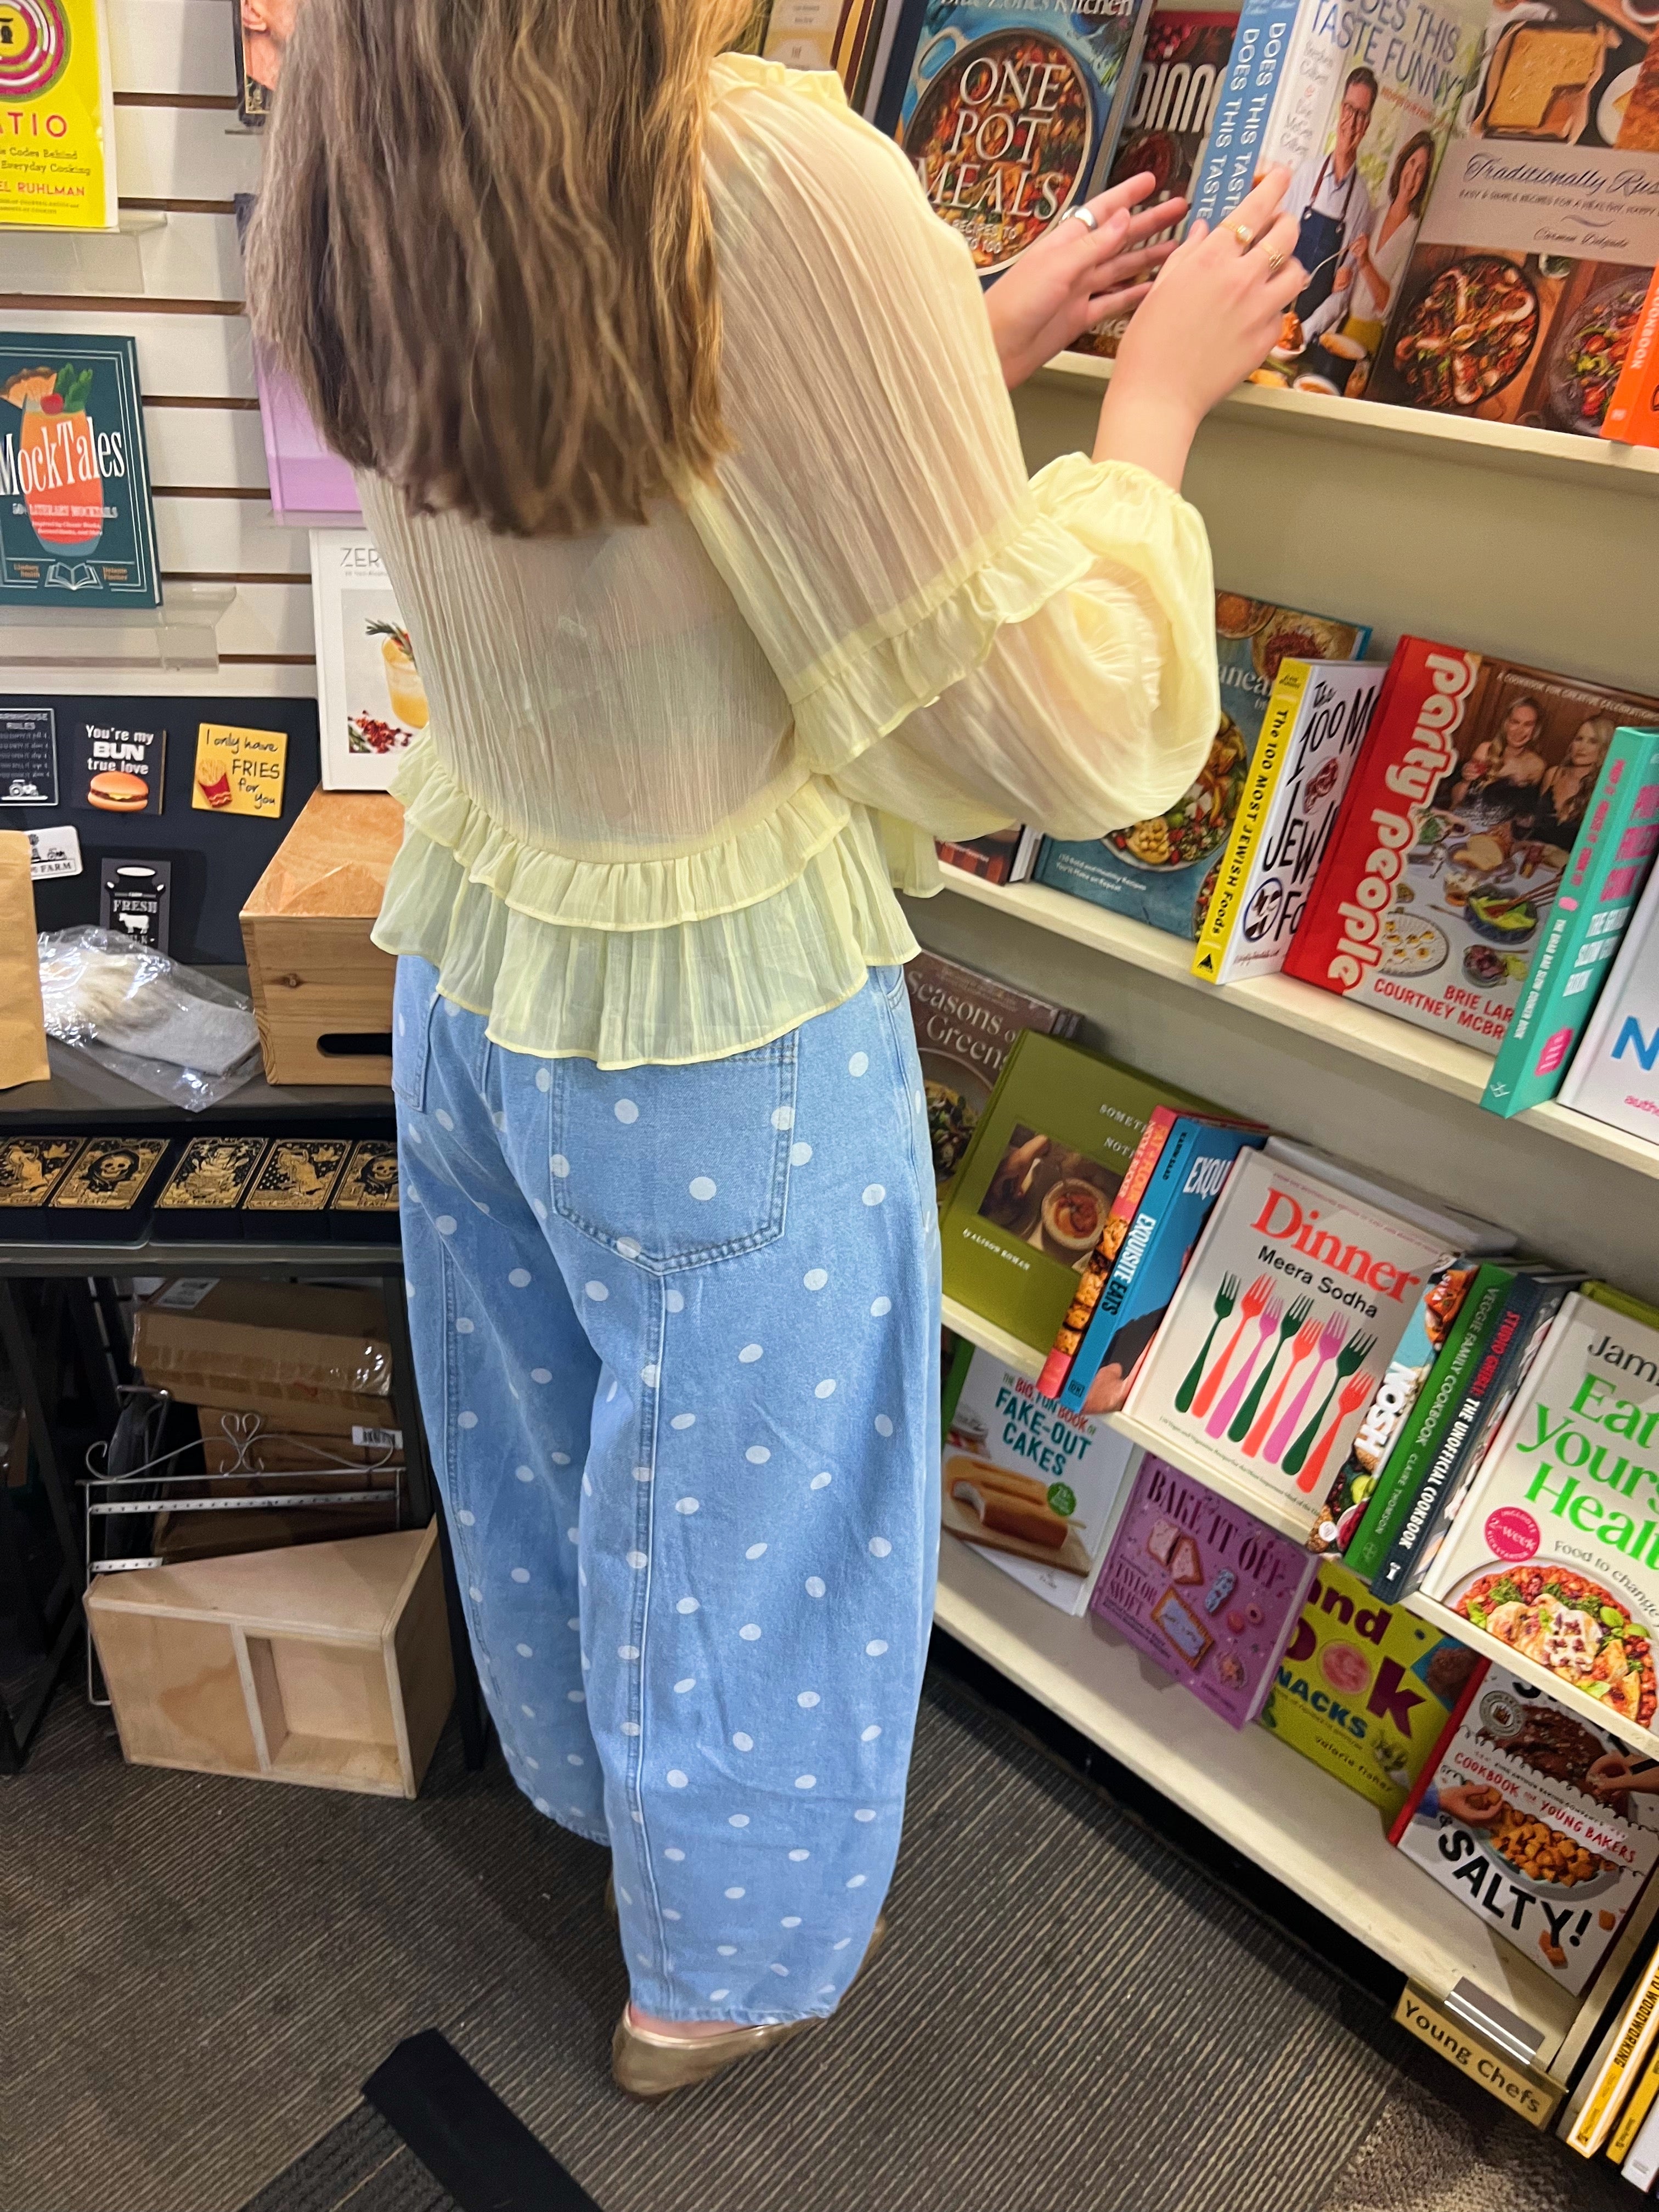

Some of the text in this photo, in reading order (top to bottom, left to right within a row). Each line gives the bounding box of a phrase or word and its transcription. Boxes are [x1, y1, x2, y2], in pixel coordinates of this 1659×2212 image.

[1256, 22, 1286, 86] DOES
[1312, 0, 1384, 66] TASTE
[1347, 0, 1460, 63] OES THIS
[960, 57, 1067, 111] ONE
[0, 112, 67, 138] TIO
[950, 109, 1053, 163] POT
[1196, 29, 1260, 218] DOES THIS TASTE
[1240, 93, 1268, 145] THIS
[18, 182, 84, 196] RUHLMAN
[916, 157, 1064, 220] MEALS
[1221, 151, 1252, 218] TASTE
[1463, 153, 1659, 197] Traditionally Rus
[0, 416, 125, 495] MockTales
[340, 548, 380, 567] ZER
[86, 724, 154, 746] You're my
[214, 733, 240, 754] only
[244, 736, 278, 753] have
[1271, 709, 1289, 738] The
[87, 758, 149, 775] true love
[93, 741, 144, 761] BUN
[232, 759, 280, 779] FRIES
[1262, 743, 1277, 770] 100
[238, 777, 261, 793] for
[254, 793, 275, 809] you
[1246, 774, 1269, 822] MOST
[1229, 825, 1254, 888] JEWISH
[1263, 780, 1340, 884] JEWI
[41, 862, 72, 873] FARM
[113, 899, 157, 913] FRESH
[1274, 891, 1307, 942] FO
[907, 970, 1003, 1035] Seasons
[1004, 1029, 1015, 1043] o
[1374, 978, 1506, 1040] COURTNEY MCBR
[1443, 985, 1515, 1023] BRIE LAR
[1099, 1104, 1147, 1133] SOMET
[1104, 1137, 1135, 1159] NOT
[1182, 1156, 1234, 1200] EXQU
[970, 1233, 1001, 1254] ALISON
[1001, 1249, 1031, 1272] ROMAN
[1102, 1213, 1156, 1316] EXQUISITE EATS
[1250, 1186, 1422, 1304] Dinner
[1257, 1245, 1378, 1319] Meera Sodha
[1587, 1335, 1659, 1386] Jam
[995, 1386, 1093, 1460] FAKE-OUT
[1058, 1406, 1089, 1432] BOOK
[1354, 1361, 1418, 1458] NOSH
[1374, 1287, 1499, 1535] VEGGIE FAMILY COOKBOOK CLAIRE THOMSON
[1458, 1397, 1481, 1424] THE
[1570, 1372, 1659, 1449] Eat
[1002, 1421, 1066, 1476] CAKES
[1433, 1417, 1470, 1487] UNOFFICIAL
[1398, 1483, 1438, 1550] COOKBOOK
[1555, 1540, 1658, 1619] Food to change
[1277, 1665, 1368, 1739] NACKS
[1454, 1752, 1636, 1864] COOKBOOK YOUNG BAKERS
[1438, 1830, 1593, 1948] SALTY!
[1404, 1999, 1473, 2066] Young
[1477, 2057, 1541, 2114] Chefs
[1613, 1990, 1659, 2069] WOODWORKING
